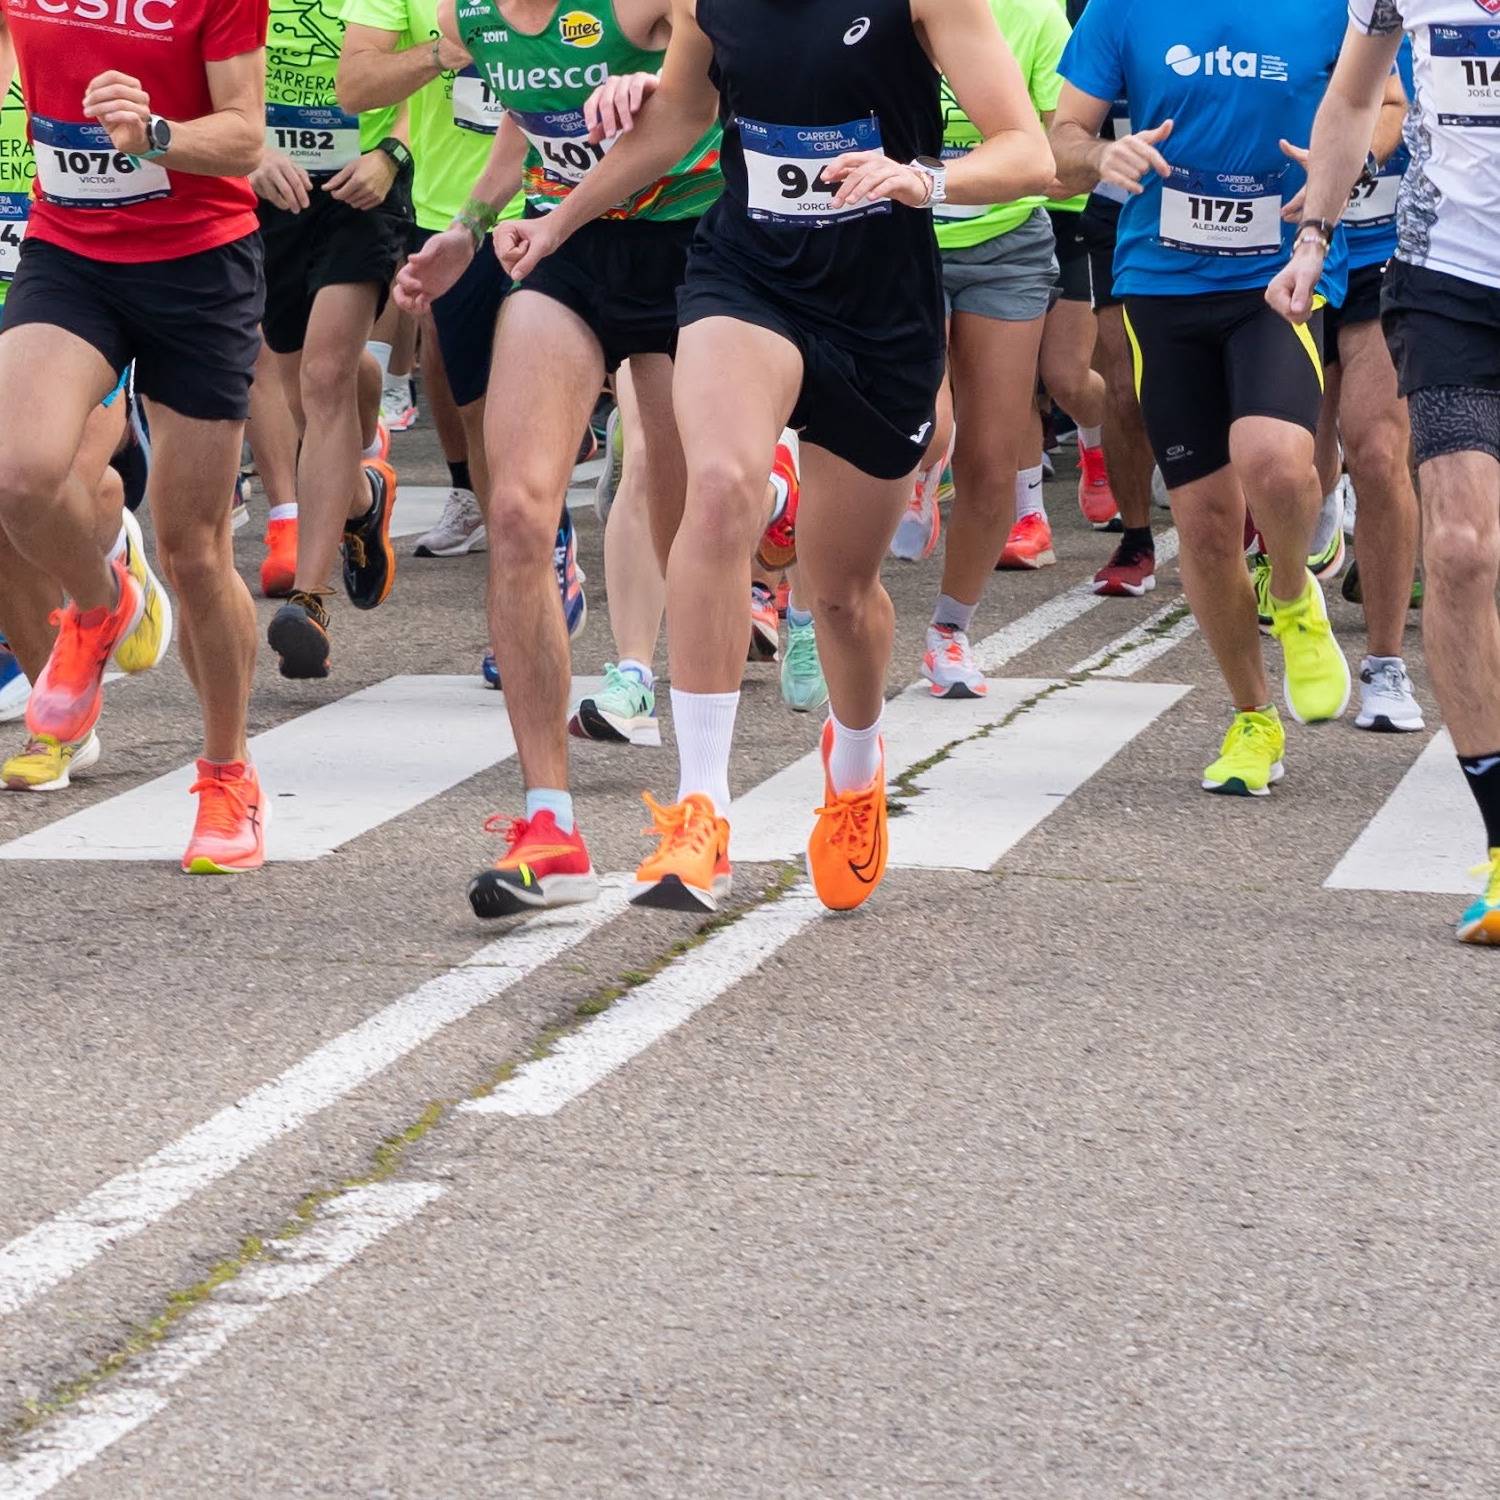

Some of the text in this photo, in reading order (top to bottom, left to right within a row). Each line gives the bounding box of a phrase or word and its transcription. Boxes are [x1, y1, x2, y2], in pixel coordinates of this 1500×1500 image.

[485, 62, 609, 91] Huesca
[1468, 88, 1492, 98] JOSÉ
[275, 129, 335, 150] 1182
[797, 130, 844, 142] CARRERA
[814, 138, 858, 151] CIENCIA
[53, 150, 136, 175] 1076
[79, 176, 116, 184] VICTOR
[1216, 174, 1255, 184] CARRERA
[1229, 183, 1265, 193] CIENCIA
[797, 202, 833, 211] JORGE
[1188, 197, 1254, 224] 1175
[1192, 222, 1248, 233] ALEJANDRO
